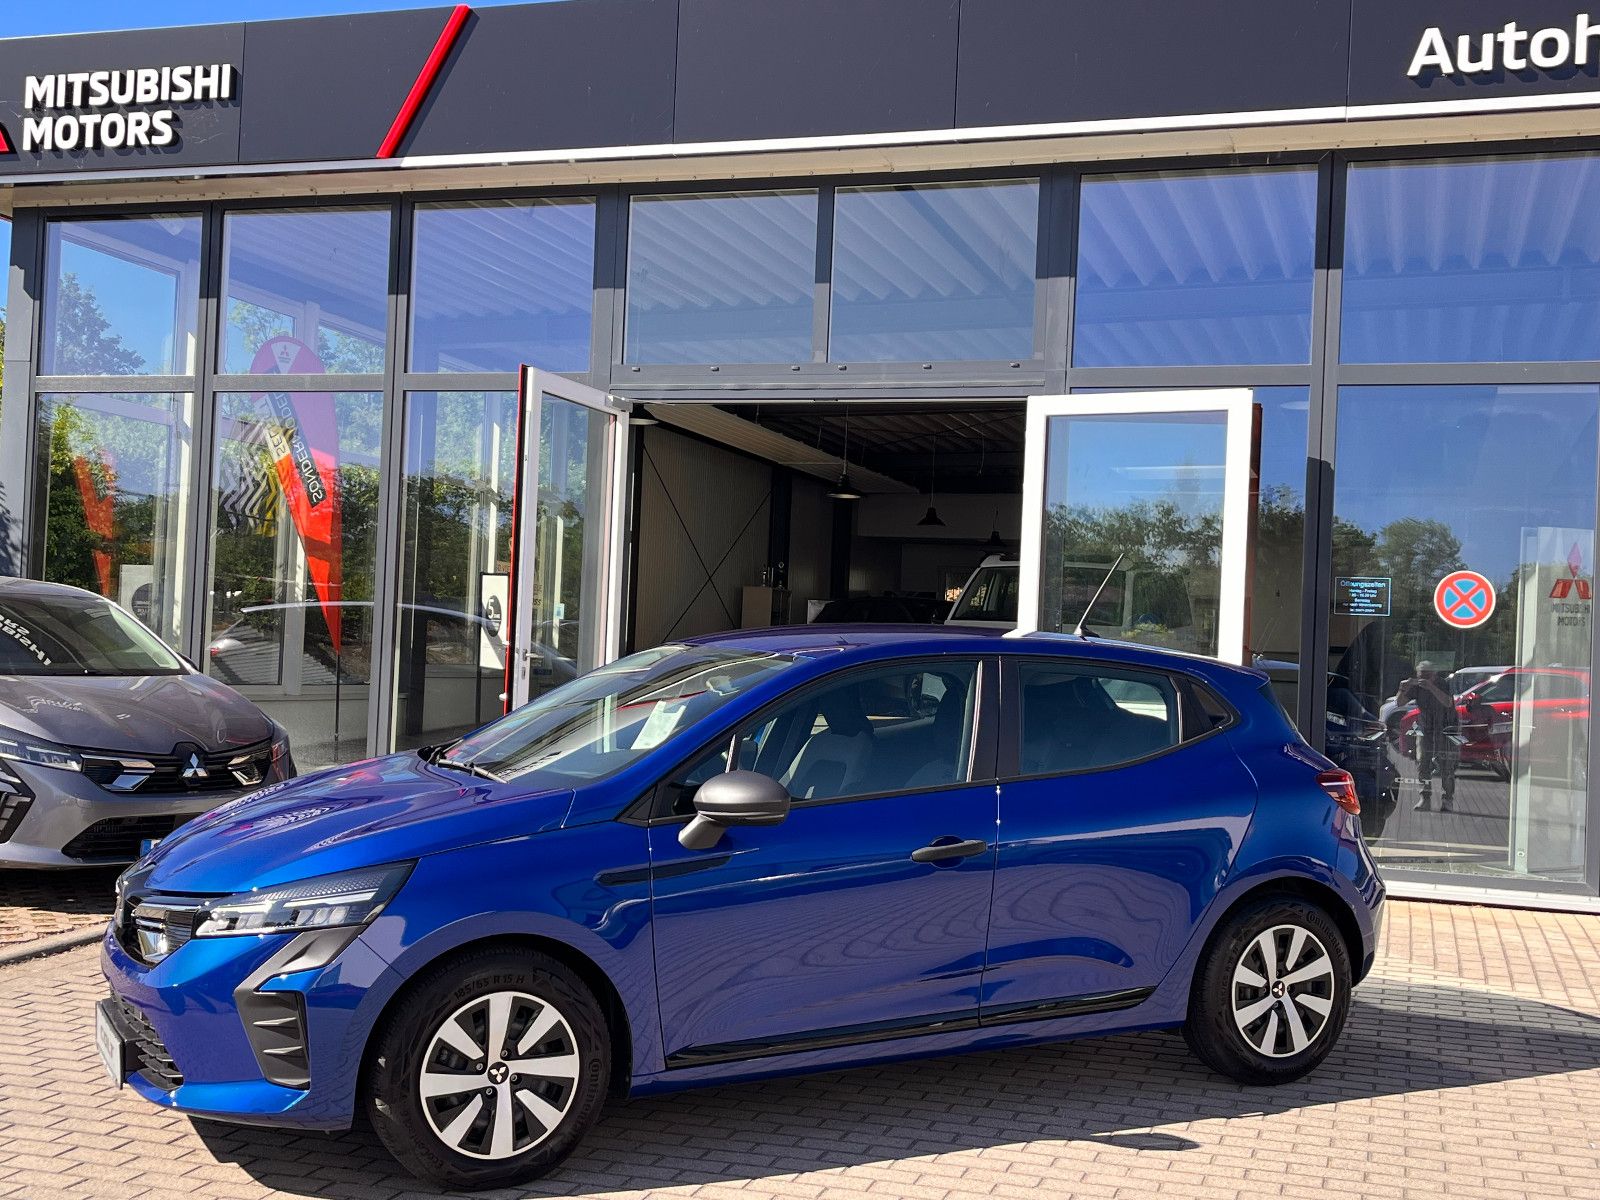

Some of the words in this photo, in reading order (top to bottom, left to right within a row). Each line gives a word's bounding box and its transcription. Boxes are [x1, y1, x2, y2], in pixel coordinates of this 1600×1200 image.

[1406, 13, 1600, 76] Autoh
[24, 63, 231, 109] MITSUBISHI
[22, 109, 174, 151] MOTORS
[1394, 777, 1432, 785] COLT
